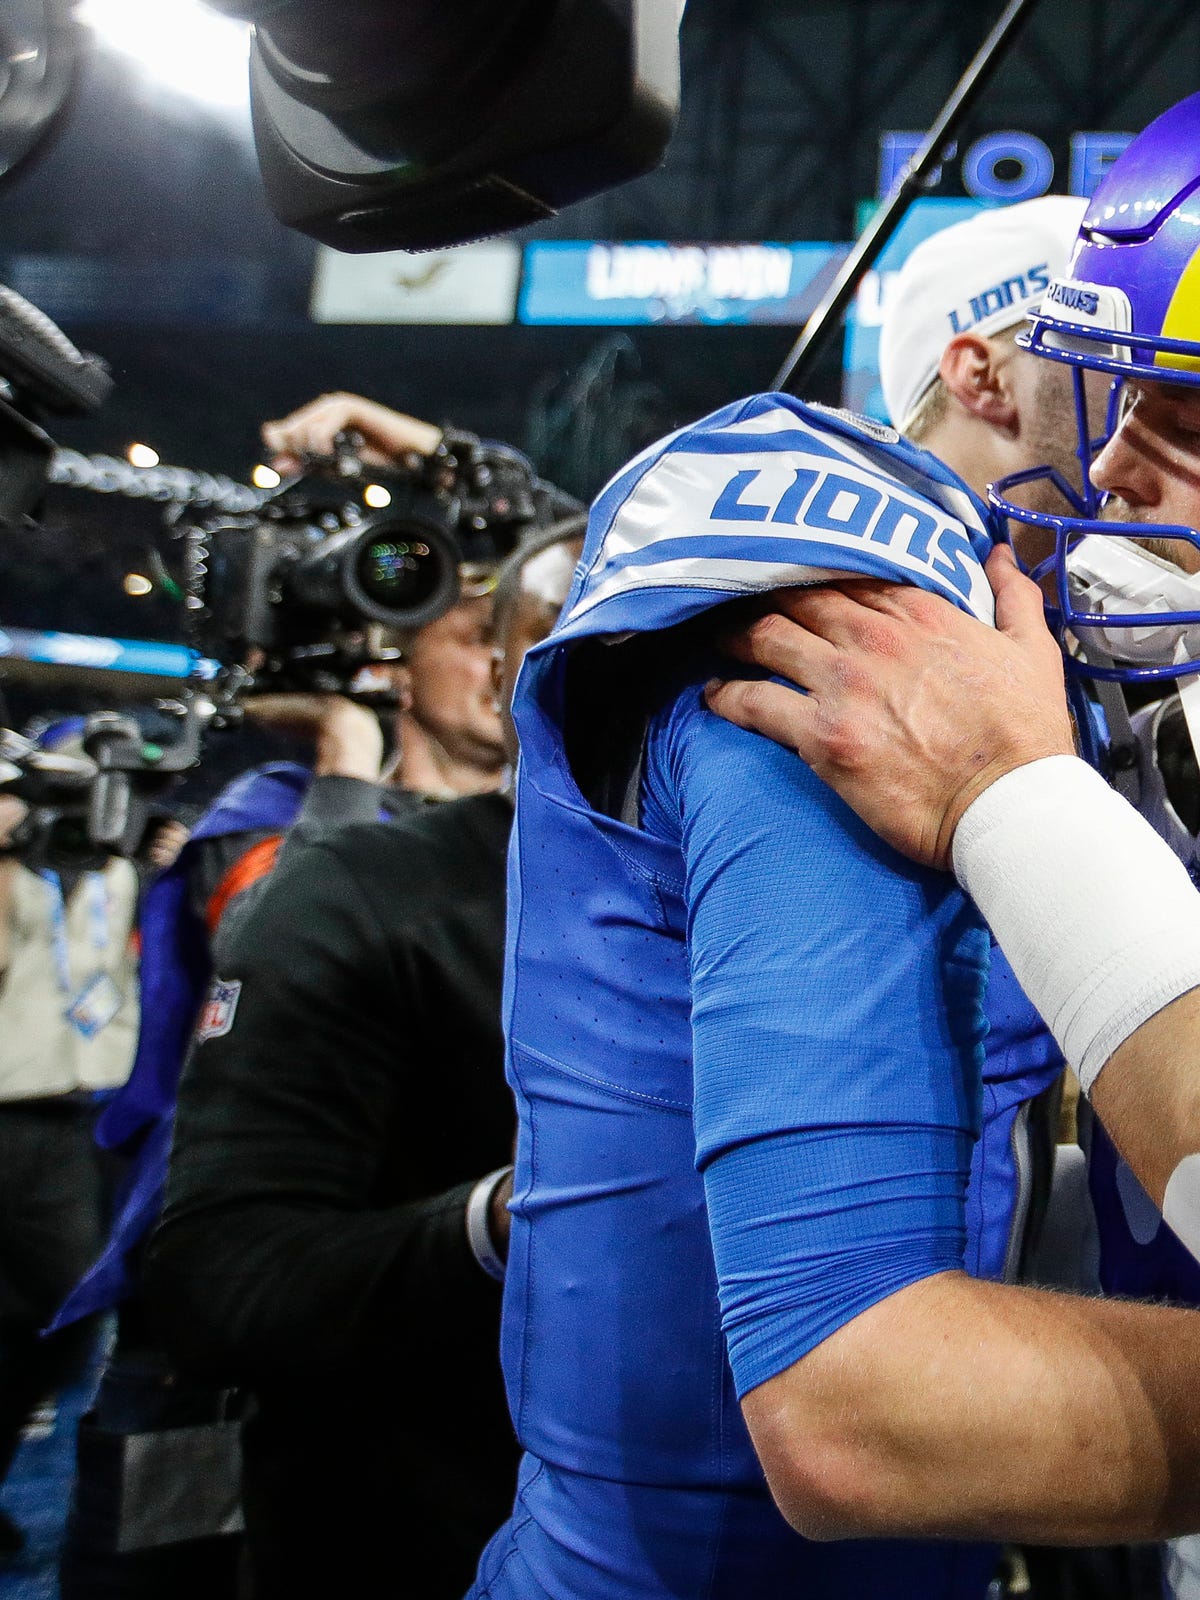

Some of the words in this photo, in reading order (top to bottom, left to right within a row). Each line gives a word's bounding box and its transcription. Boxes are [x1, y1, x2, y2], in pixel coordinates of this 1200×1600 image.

[947, 262, 1050, 335] LIONS
[1047, 282, 1100, 316] RAMS
[709, 468, 980, 601] LIONS
